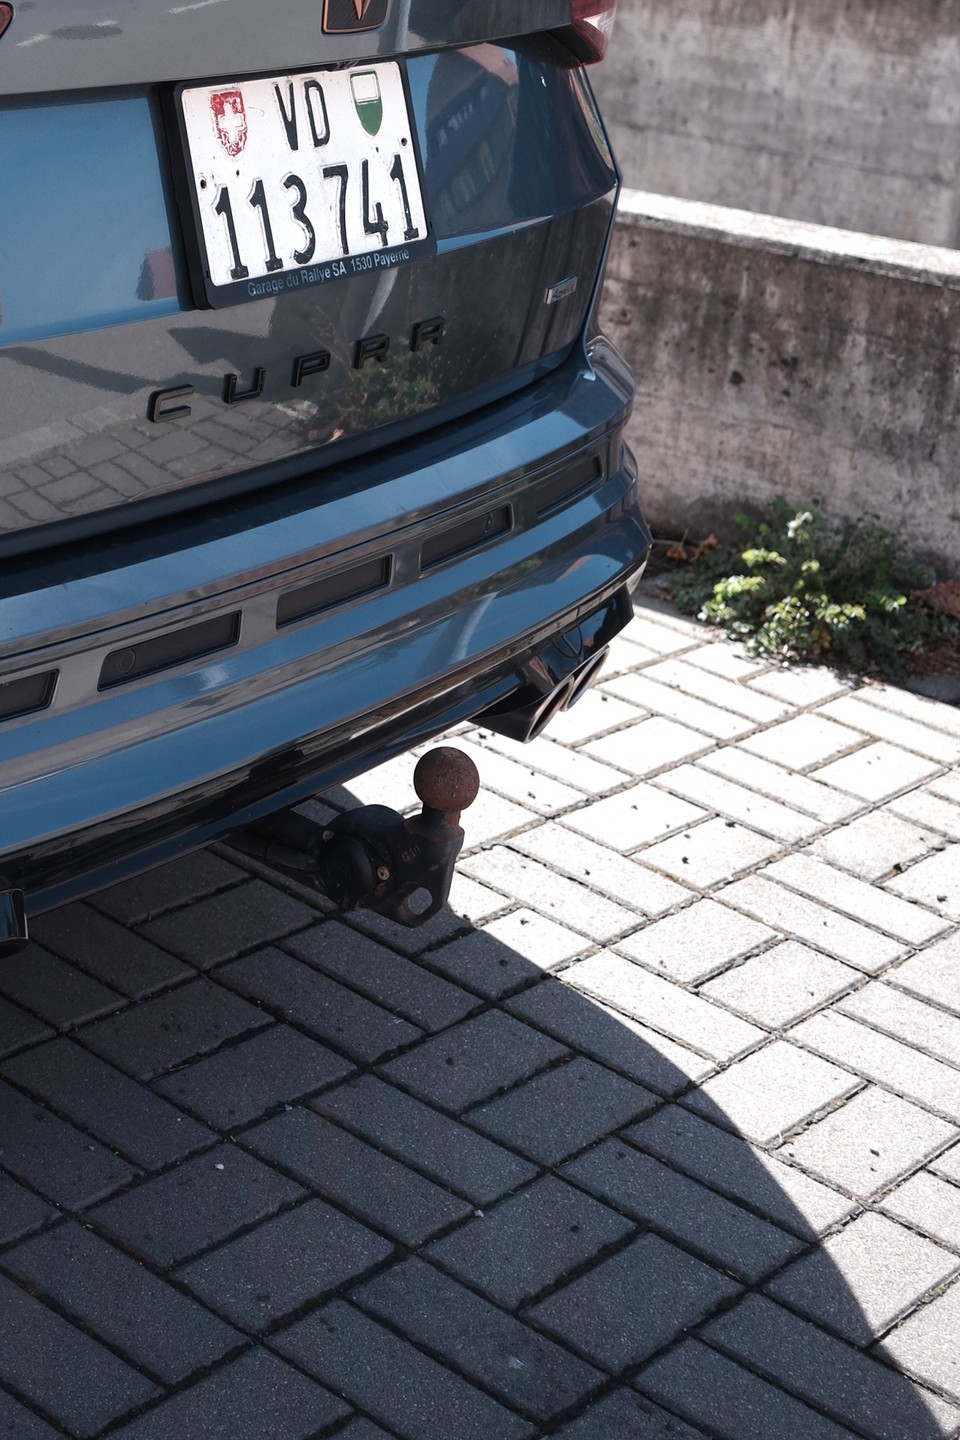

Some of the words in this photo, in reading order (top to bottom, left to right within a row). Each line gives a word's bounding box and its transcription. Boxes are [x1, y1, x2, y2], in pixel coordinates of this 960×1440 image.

[274, 79, 330, 150] VD
[214, 154, 419, 280] 113741
[247, 278, 284, 296] Garage
[287, 273, 299, 288] du
[332, 261, 347, 277] SA
[350, 255, 373, 272] 1530
[374, 249, 410, 268] Payerne
[146, 316, 444, 423] CUPRA
